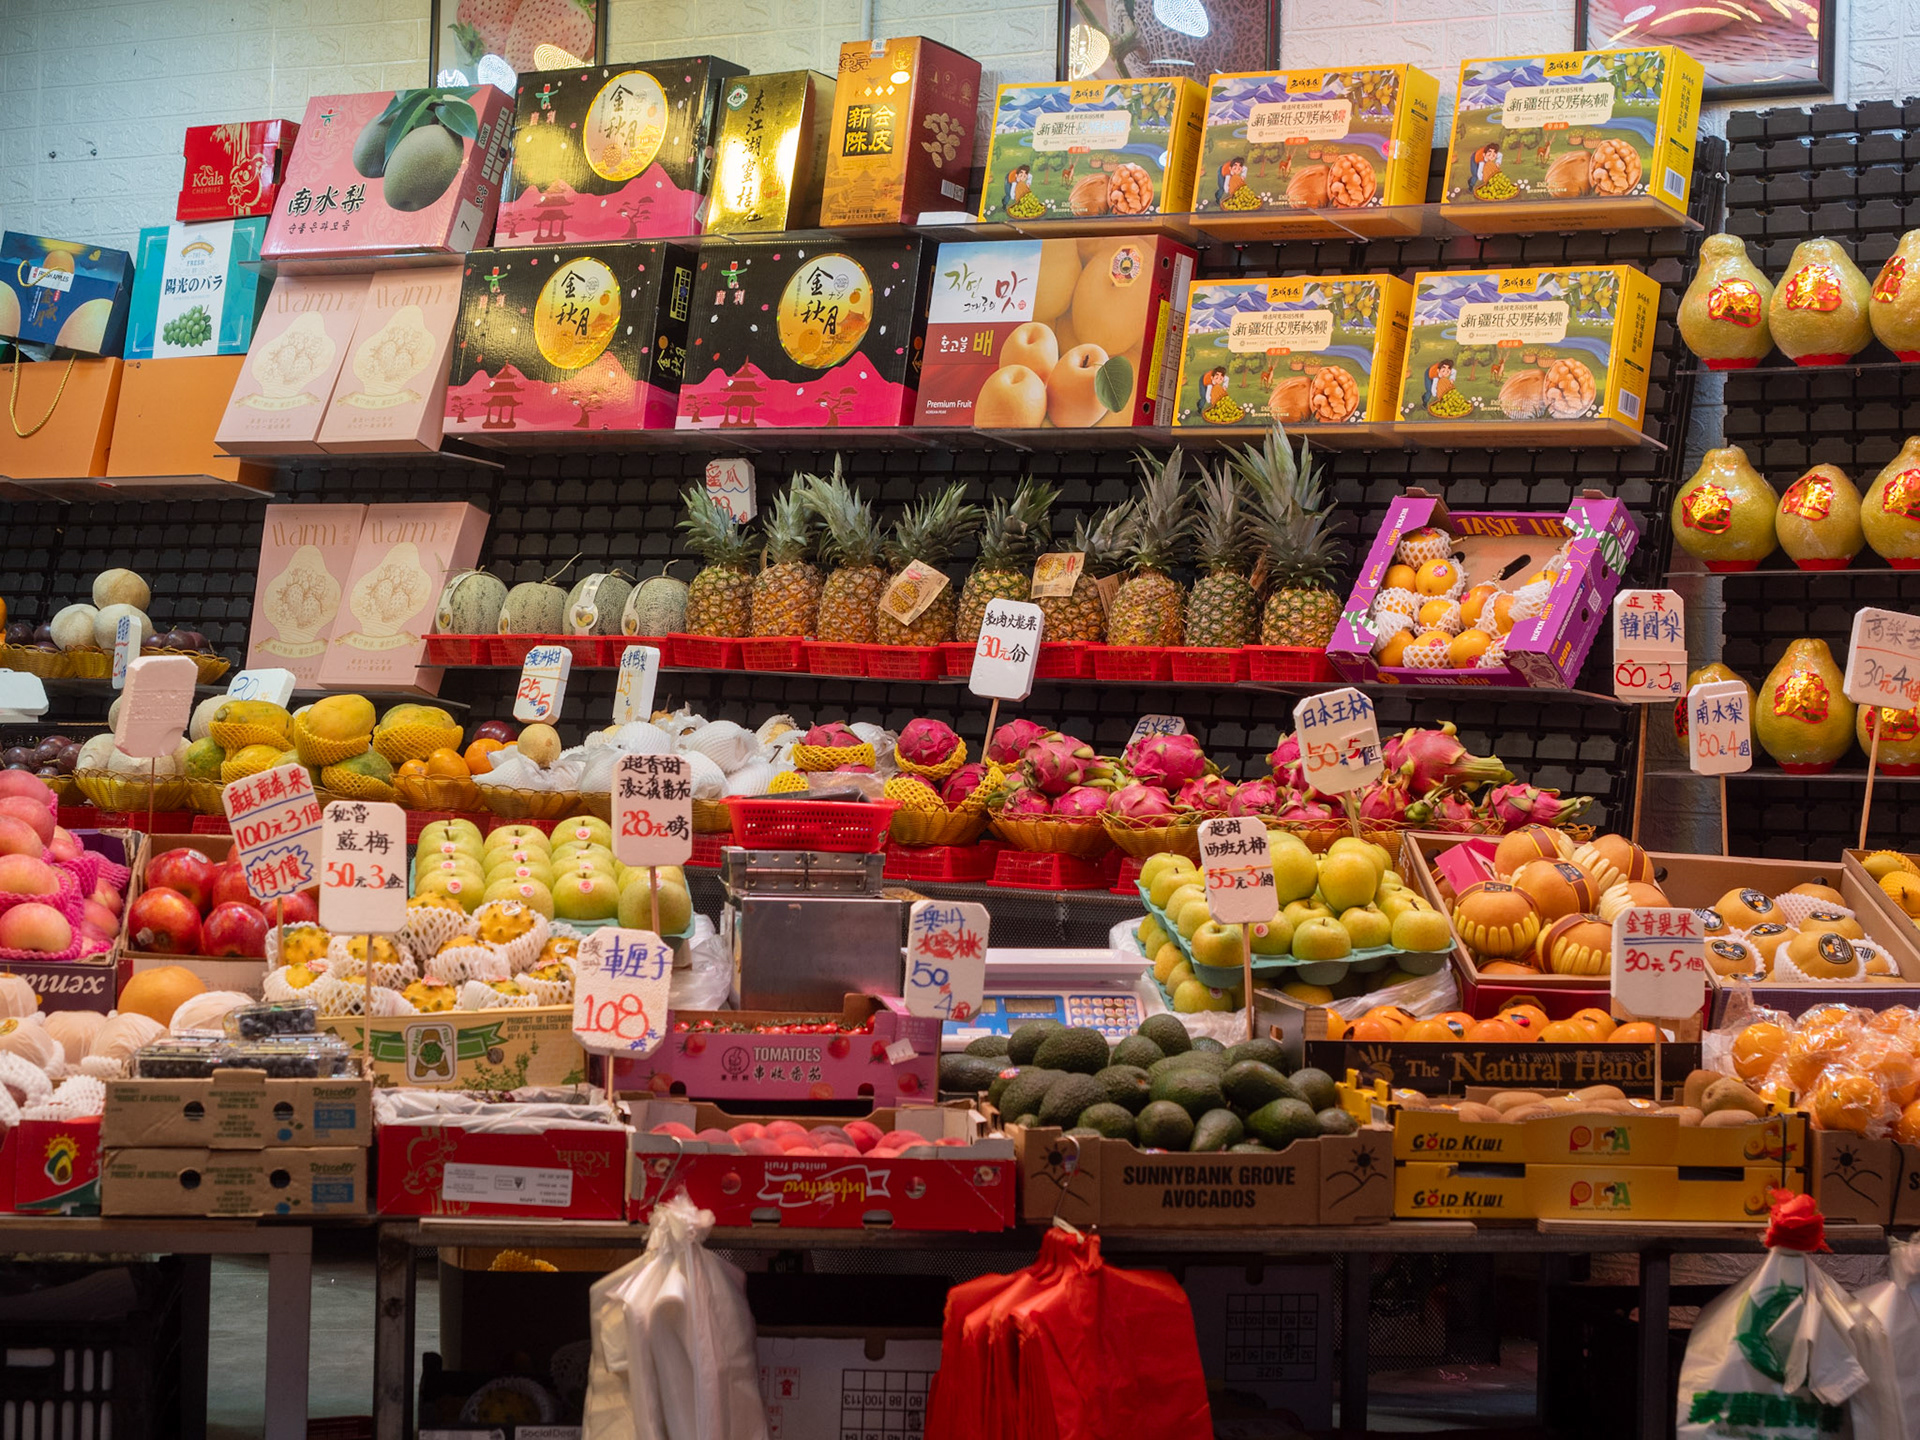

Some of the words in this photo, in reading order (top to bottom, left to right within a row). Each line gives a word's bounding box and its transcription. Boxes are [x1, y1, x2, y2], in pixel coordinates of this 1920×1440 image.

[848, 105, 896, 129] 新会
[845, 130, 892, 153] 陈皮
[192, 170, 224, 187] Koala
[287, 183, 366, 217] 南水梨
[165, 275, 223, 295] 陽光のバラ
[944, 263, 983, 298] 자연
[995, 271, 1028, 313] 맛
[555, 270, 590, 336] 金秋月
[801, 266, 839, 335] 金秋月
[973, 330, 994, 356] 배
[926, 400, 956, 408] Premium
[957, 400, 972, 408] Fruit
[1456, 516, 1522, 537] TASTE
[1626, 593, 1666, 612] 正宗
[1620, 609, 1683, 642] 韓國梨
[525, 648, 561, 666] 澳洲柑
[978, 635, 1030, 663] 30元份
[1302, 692, 1374, 729] 日本王林
[1696, 697, 1744, 725] 南水梨
[1698, 731, 1750, 758] 50元4個
[621, 755, 685, 775] 超香甜
[230, 767, 311, 818] 麒麟果
[328, 803, 370, 823] 秘魯
[236, 802, 323, 850] 100元3個
[622, 810, 689, 840] 28元磅
[1209, 820, 1241, 836] 超甜
[336, 829, 394, 855] 藍梅
[1205, 836, 1267, 857] 西班牙柿
[252, 854, 308, 893] 特價
[325, 861, 404, 889] 50元3盒
[1209, 865, 1274, 891] 55元3個
[1626, 910, 1698, 937] 金奇異果
[601, 935, 673, 981] 車厘子
[1624, 948, 1704, 974] 30元5個
[507, 1016, 532, 1024] PRODUCT
[507, 1024, 520, 1032] KEEP
[522, 1023, 561, 1031] REFRIGERATED
[753, 1047, 821, 1062] TOMATOES
[1405, 1060, 1440, 1077] The
[1452, 1052, 1561, 1081] Natural
[1575, 1050, 1654, 1081] Hand
[1412, 1131, 1460, 1150] GOLD
[1462, 1135, 1503, 1150] KIWI
[556, 1150, 610, 1168] Koala
[764, 1161, 788, 1171] fruit
[792, 1161, 827, 1170] united
[1123, 1165, 1233, 1185] SUNNYBANK
[1238, 1166, 1296, 1185] GROVE
[783, 1177, 865, 1203] Infantino
[1162, 1189, 1256, 1208] AVOCADOS
[1413, 1188, 1460, 1207] GOLD
[1463, 1191, 1503, 1207] KIWI
[1256, 1367, 1283, 1377] SIZE
[844, 1394, 861, 1405] 113
[864, 1394, 883, 1406] 100
[889, 1395, 902, 1406] 88
